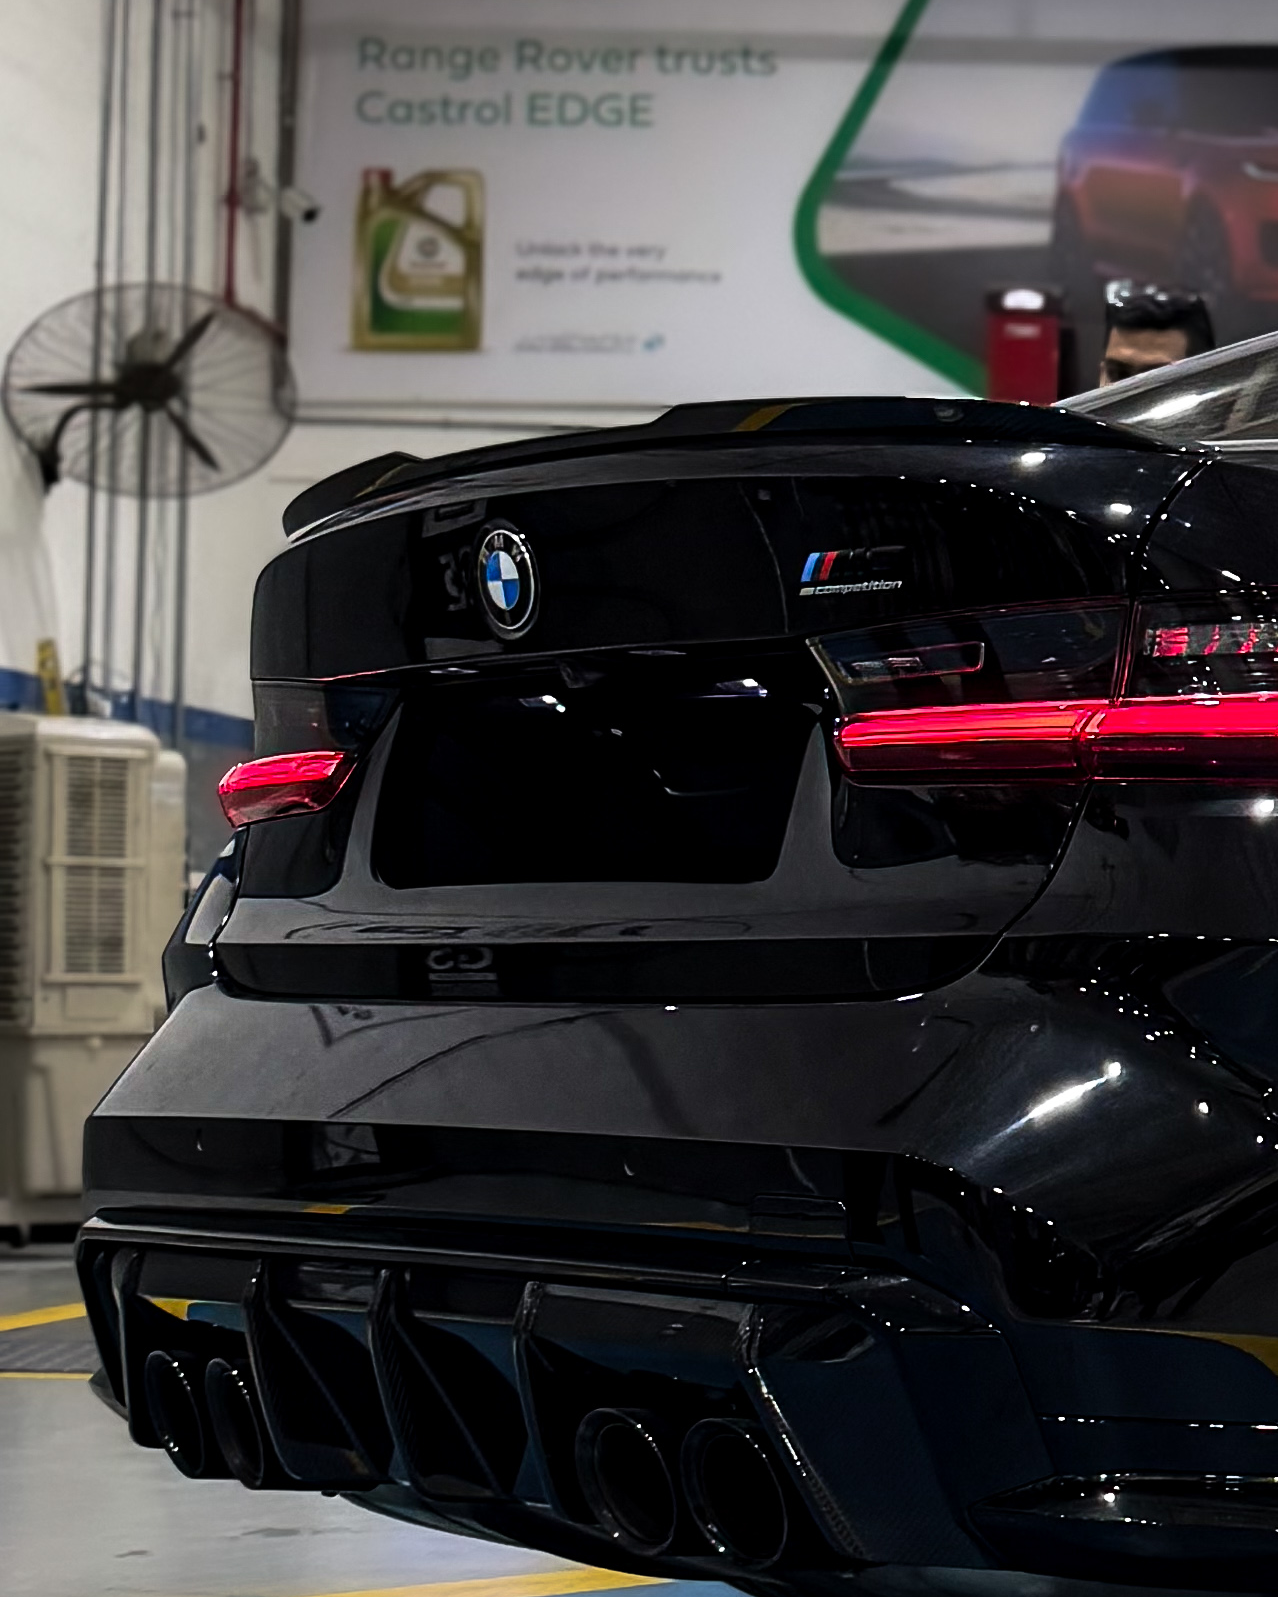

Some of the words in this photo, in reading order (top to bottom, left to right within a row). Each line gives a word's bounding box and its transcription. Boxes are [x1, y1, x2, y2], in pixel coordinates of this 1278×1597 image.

[356, 36, 500, 82] Range
[514, 38, 642, 74] Rover
[654, 43, 779, 76] trusts
[355, 89, 511, 126] Castrol
[526, 92, 654, 128] EDGE
